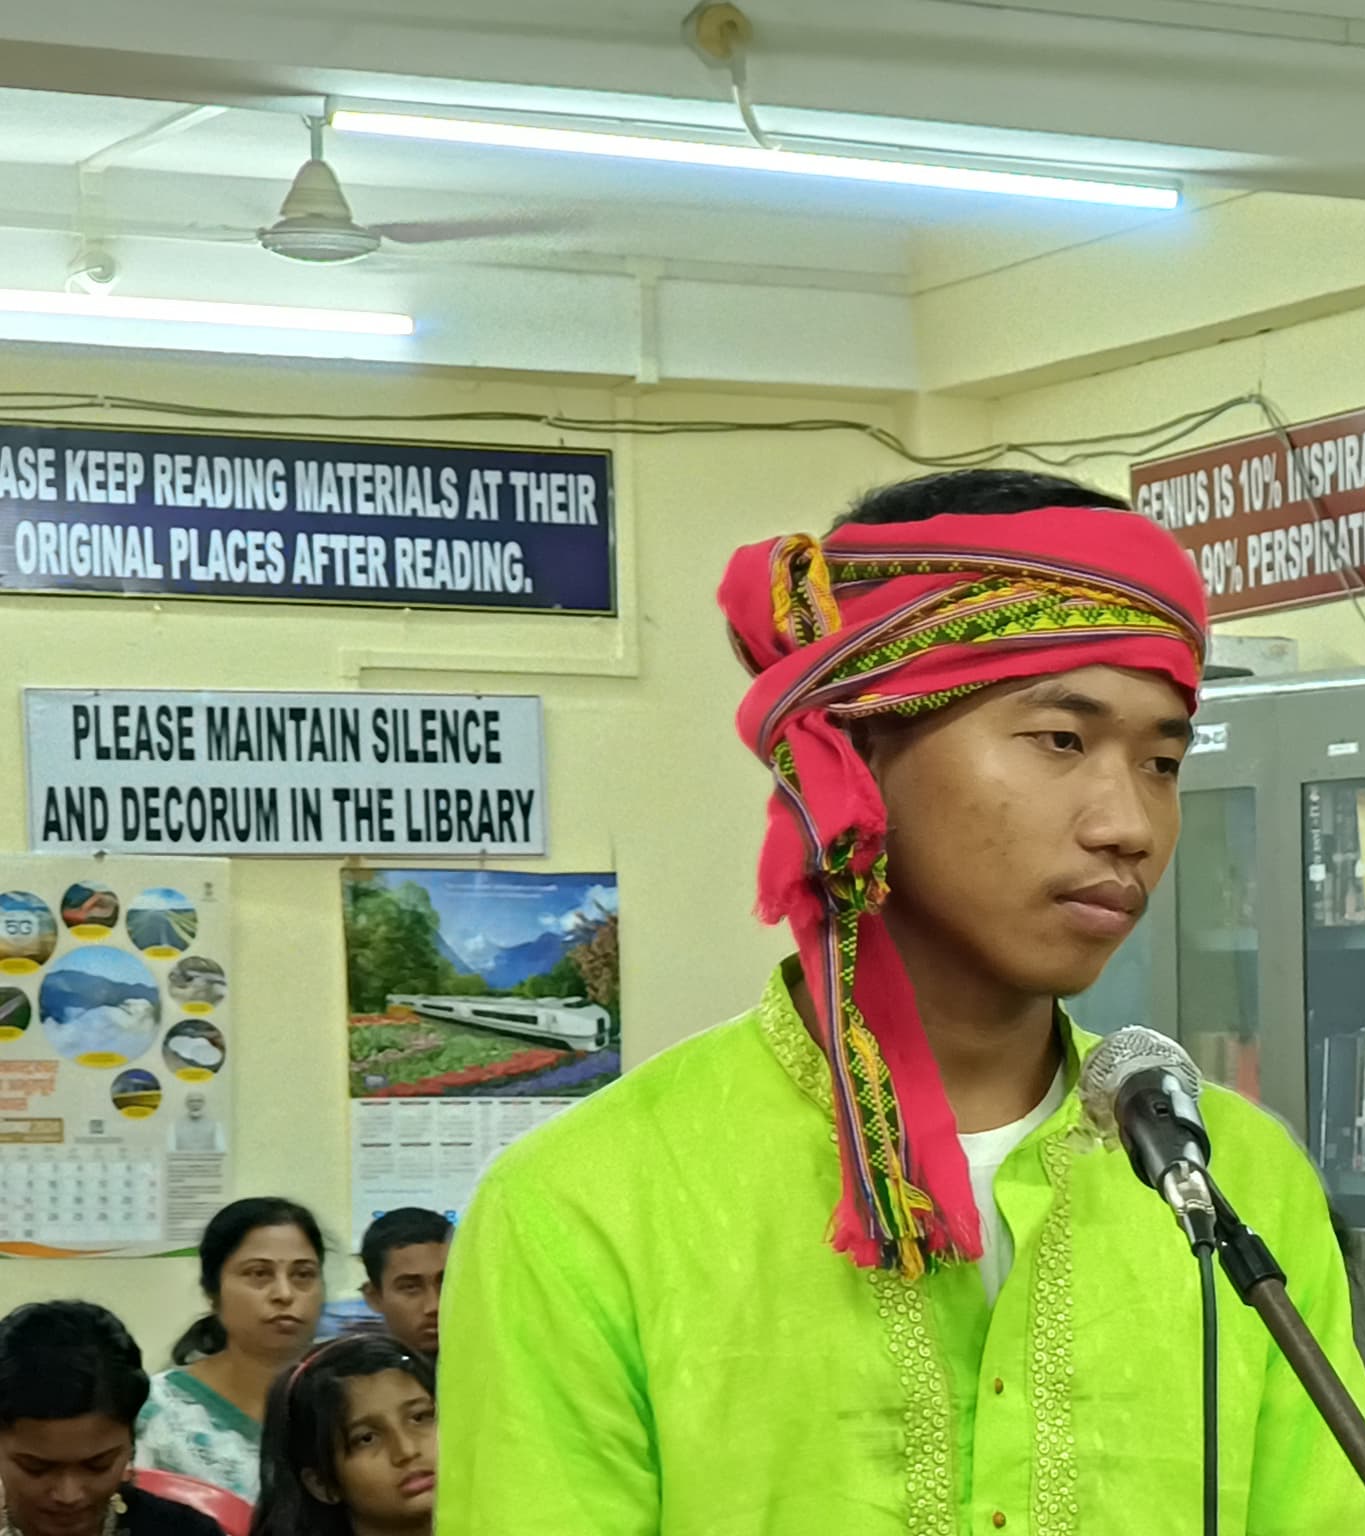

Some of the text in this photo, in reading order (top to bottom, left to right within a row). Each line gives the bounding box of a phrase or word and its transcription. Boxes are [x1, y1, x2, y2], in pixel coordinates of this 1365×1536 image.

[65, 449, 145, 505] KEEP
[153, 454, 287, 512] READING
[295, 460, 457, 520] MATERIALS
[466, 468, 503, 522] AT
[509, 470, 598, 526] THEIR
[1137, 470, 1209, 529] GENIUS
[1213, 464, 1235, 519] IS
[1239, 452, 1283, 513] 10%
[15, 520, 533, 594] ORIGINAL PLACES AFTER READING.
[1202, 538, 1244, 596] 90%
[73, 704, 502, 764] PLEASE MAINTAIN SILENCE
[43, 785, 535, 845] AND DECORUM IN THE LIBRARY
[5, 918, 33, 936] 5G
